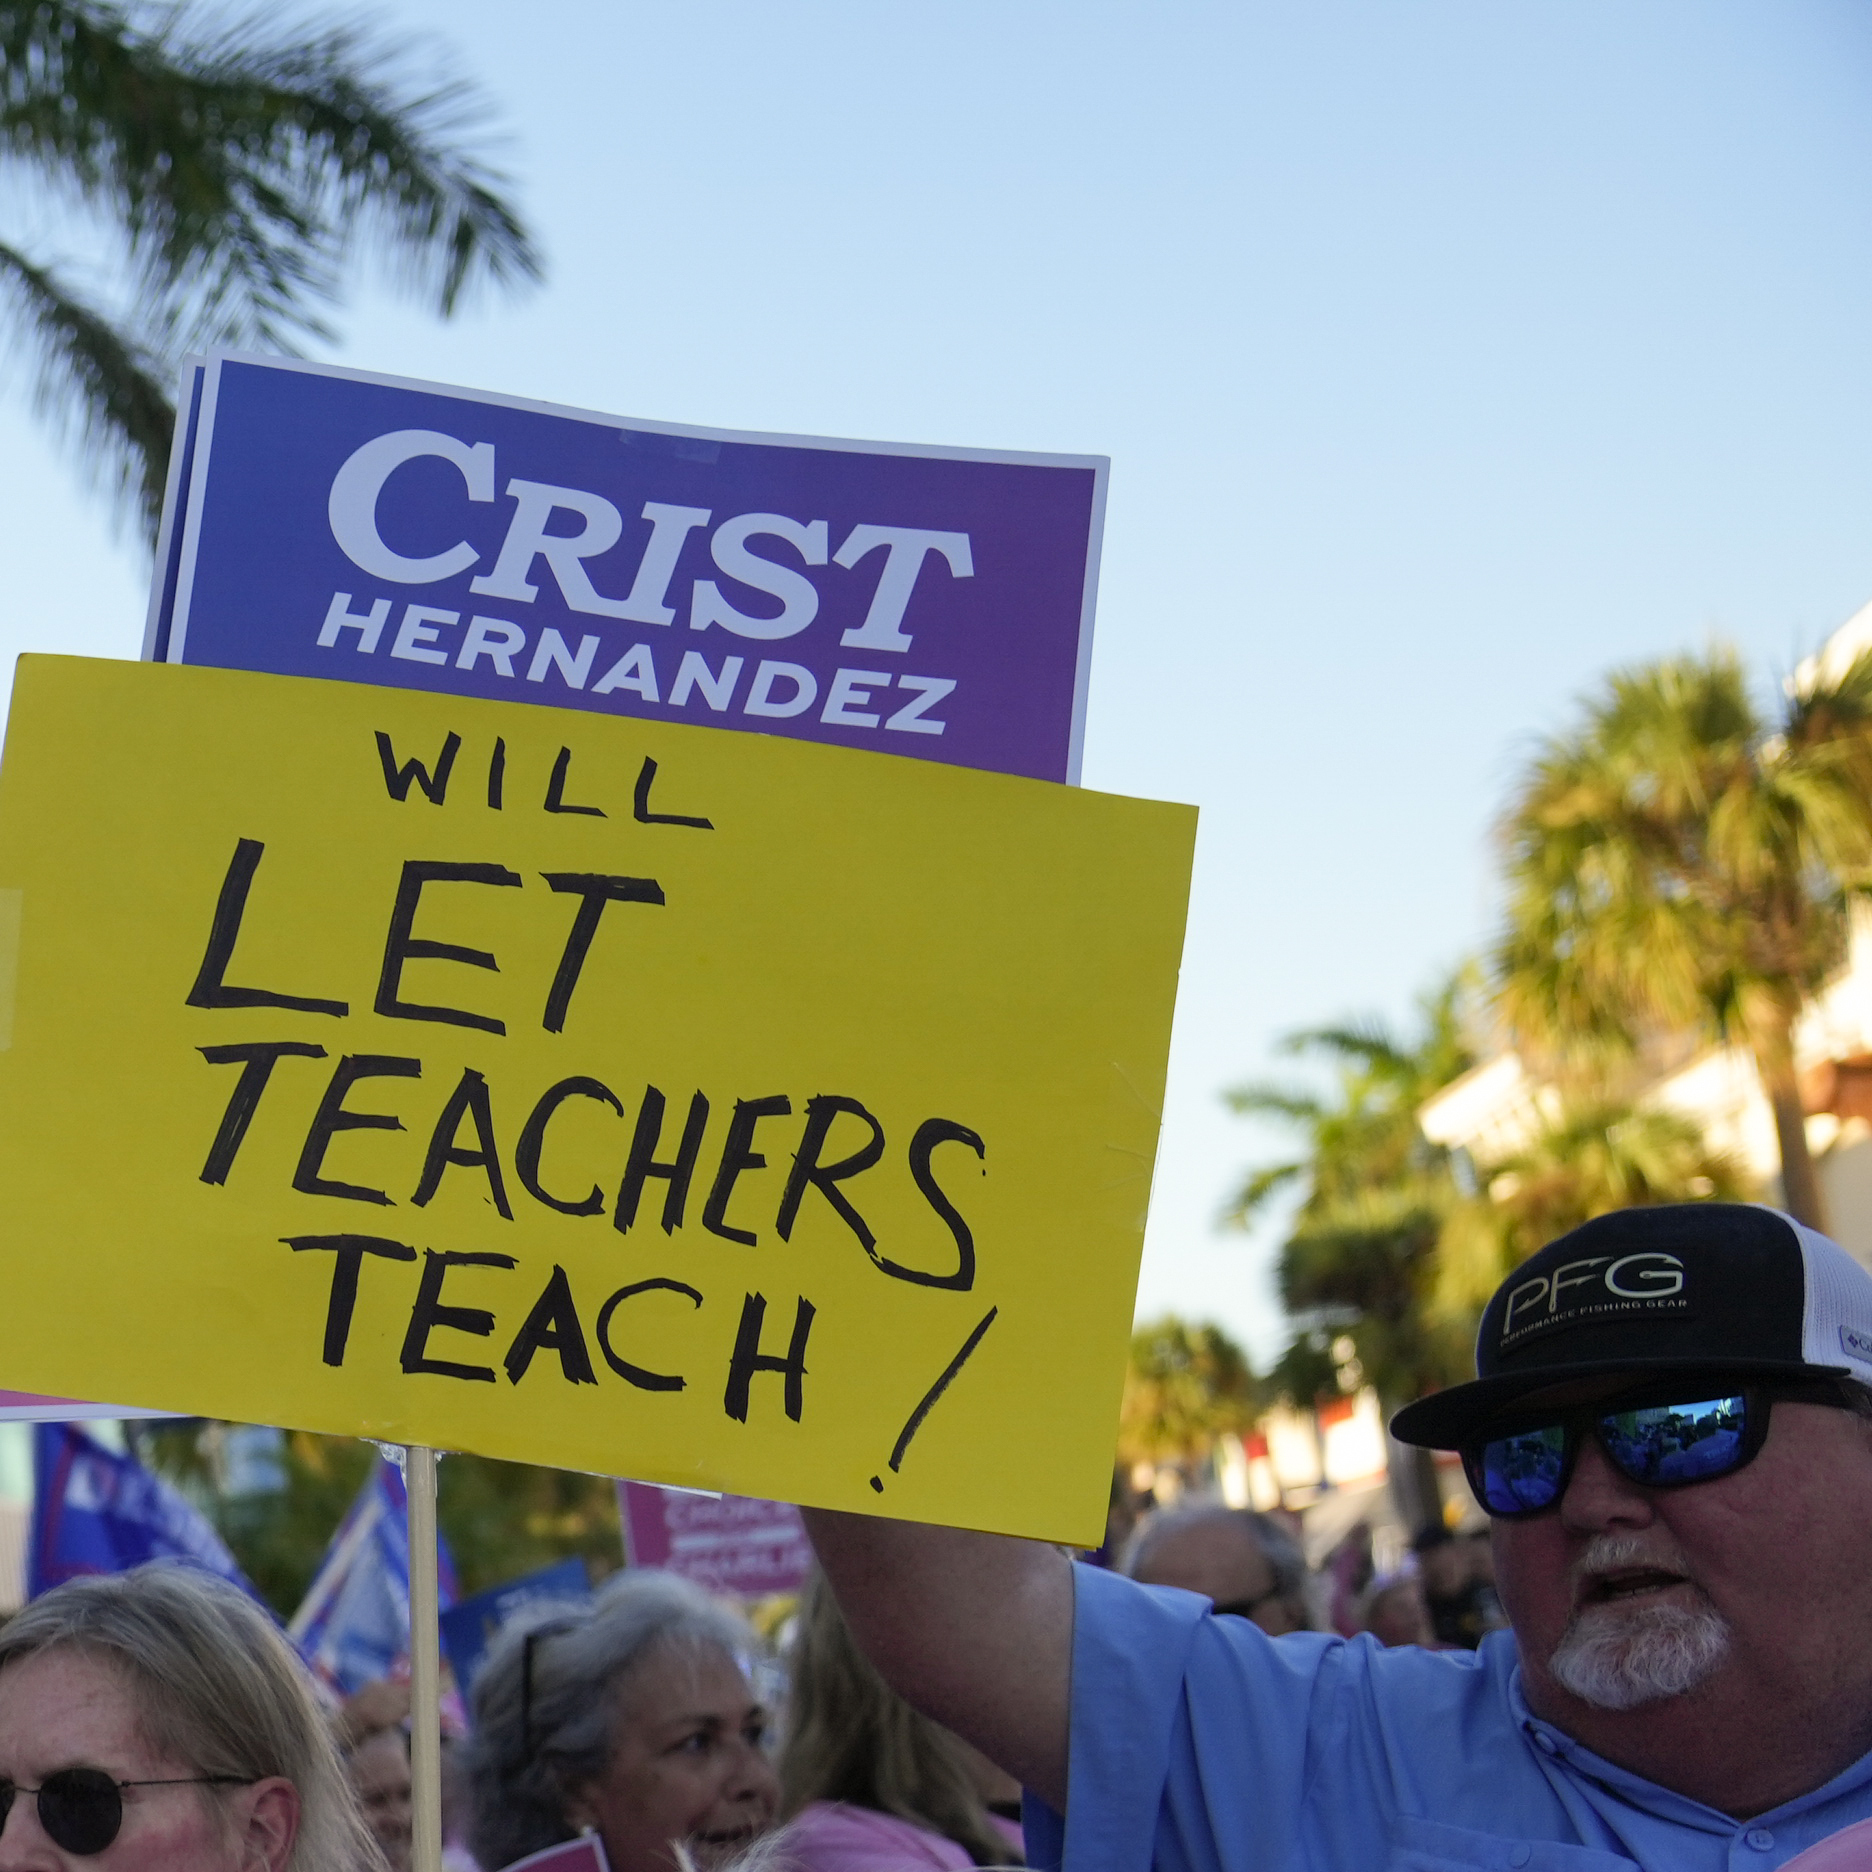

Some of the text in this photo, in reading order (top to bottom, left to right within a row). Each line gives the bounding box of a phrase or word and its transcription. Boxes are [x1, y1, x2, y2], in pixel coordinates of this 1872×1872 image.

[328, 429, 974, 652] CRIST
[315, 591, 956, 735] HERNANDEZ
[374, 731, 715, 829] WILL
[185, 837, 665, 1035] LET
[195, 1044, 986, 1292] TEACHERS
[279, 1234, 816, 1424] TEACH
[1503, 1252, 1684, 1335] PFG
[1579, 1299, 1641, 1315] FISHING
[1646, 1299, 1688, 1309] GEAR
